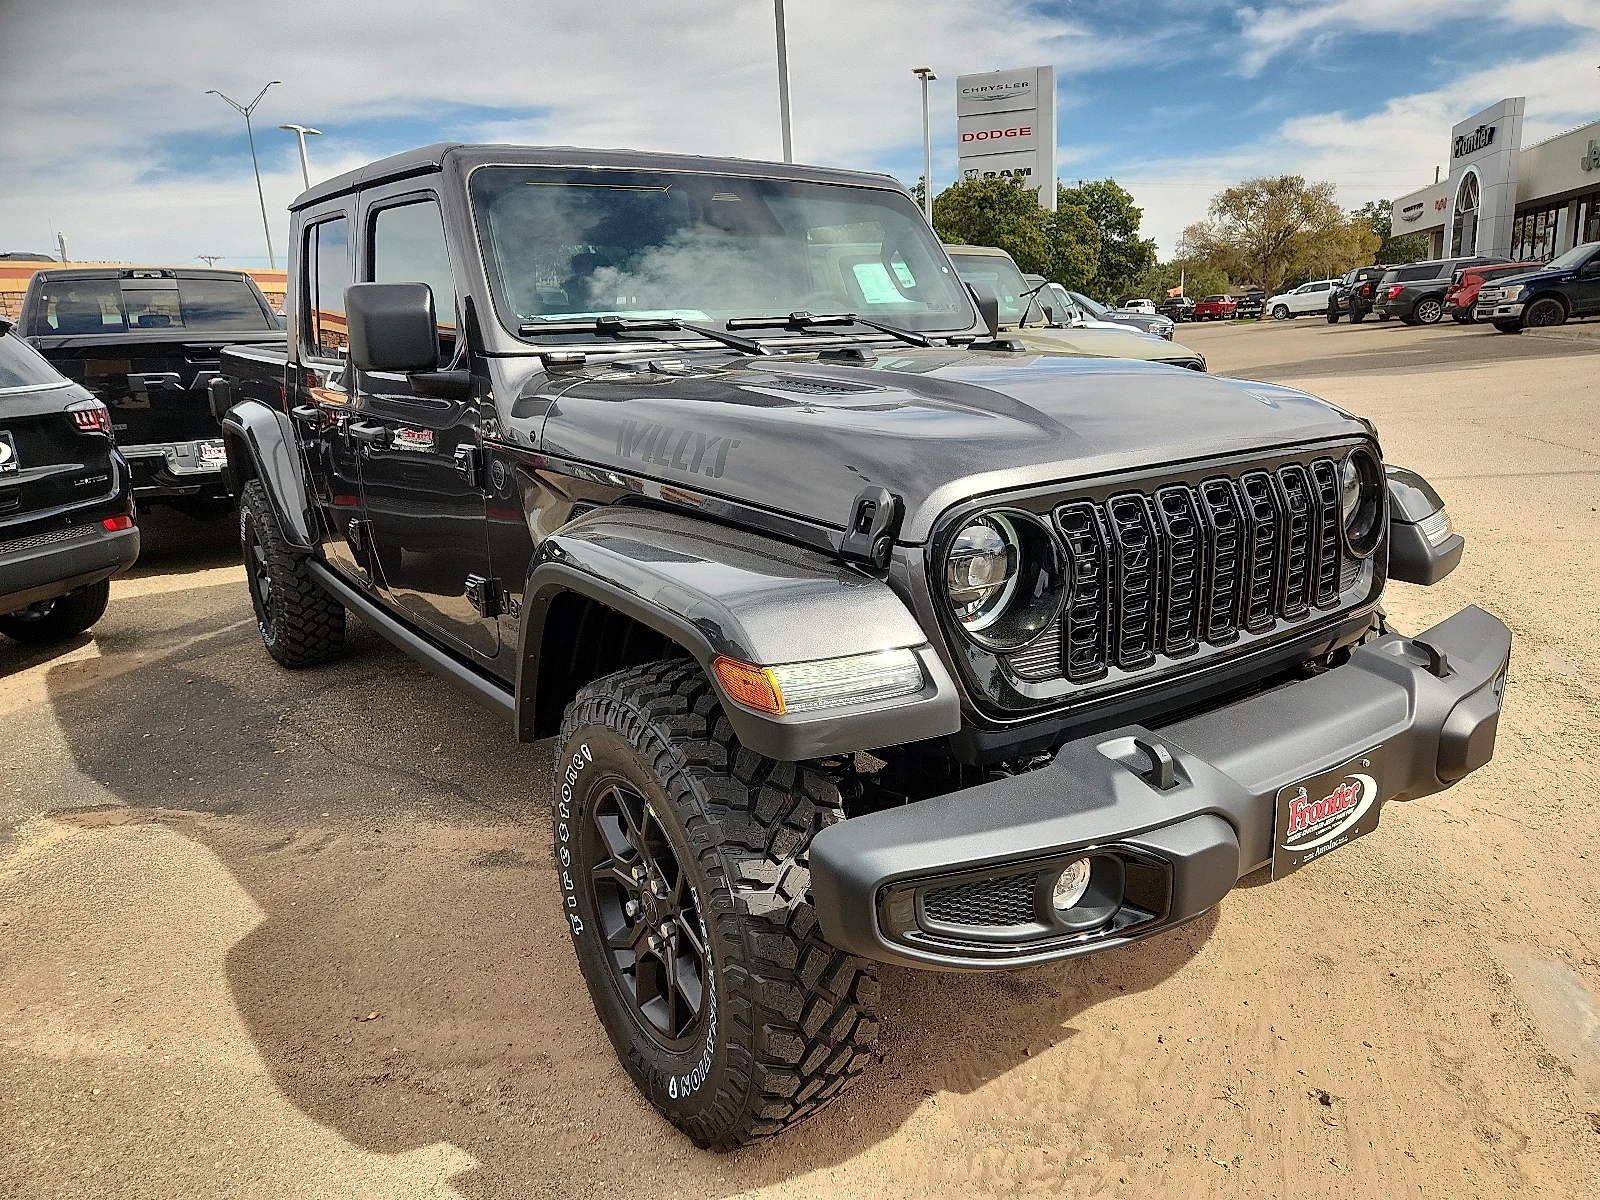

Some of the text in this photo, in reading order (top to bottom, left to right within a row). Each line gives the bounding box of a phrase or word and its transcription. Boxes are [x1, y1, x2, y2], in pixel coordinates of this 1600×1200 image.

[962, 81, 1029, 94] CHRYSLER
[962, 127, 1032, 142] DODGE
[615, 419, 741, 478] WILLYS
[1287, 782, 1361, 835] Frontier
